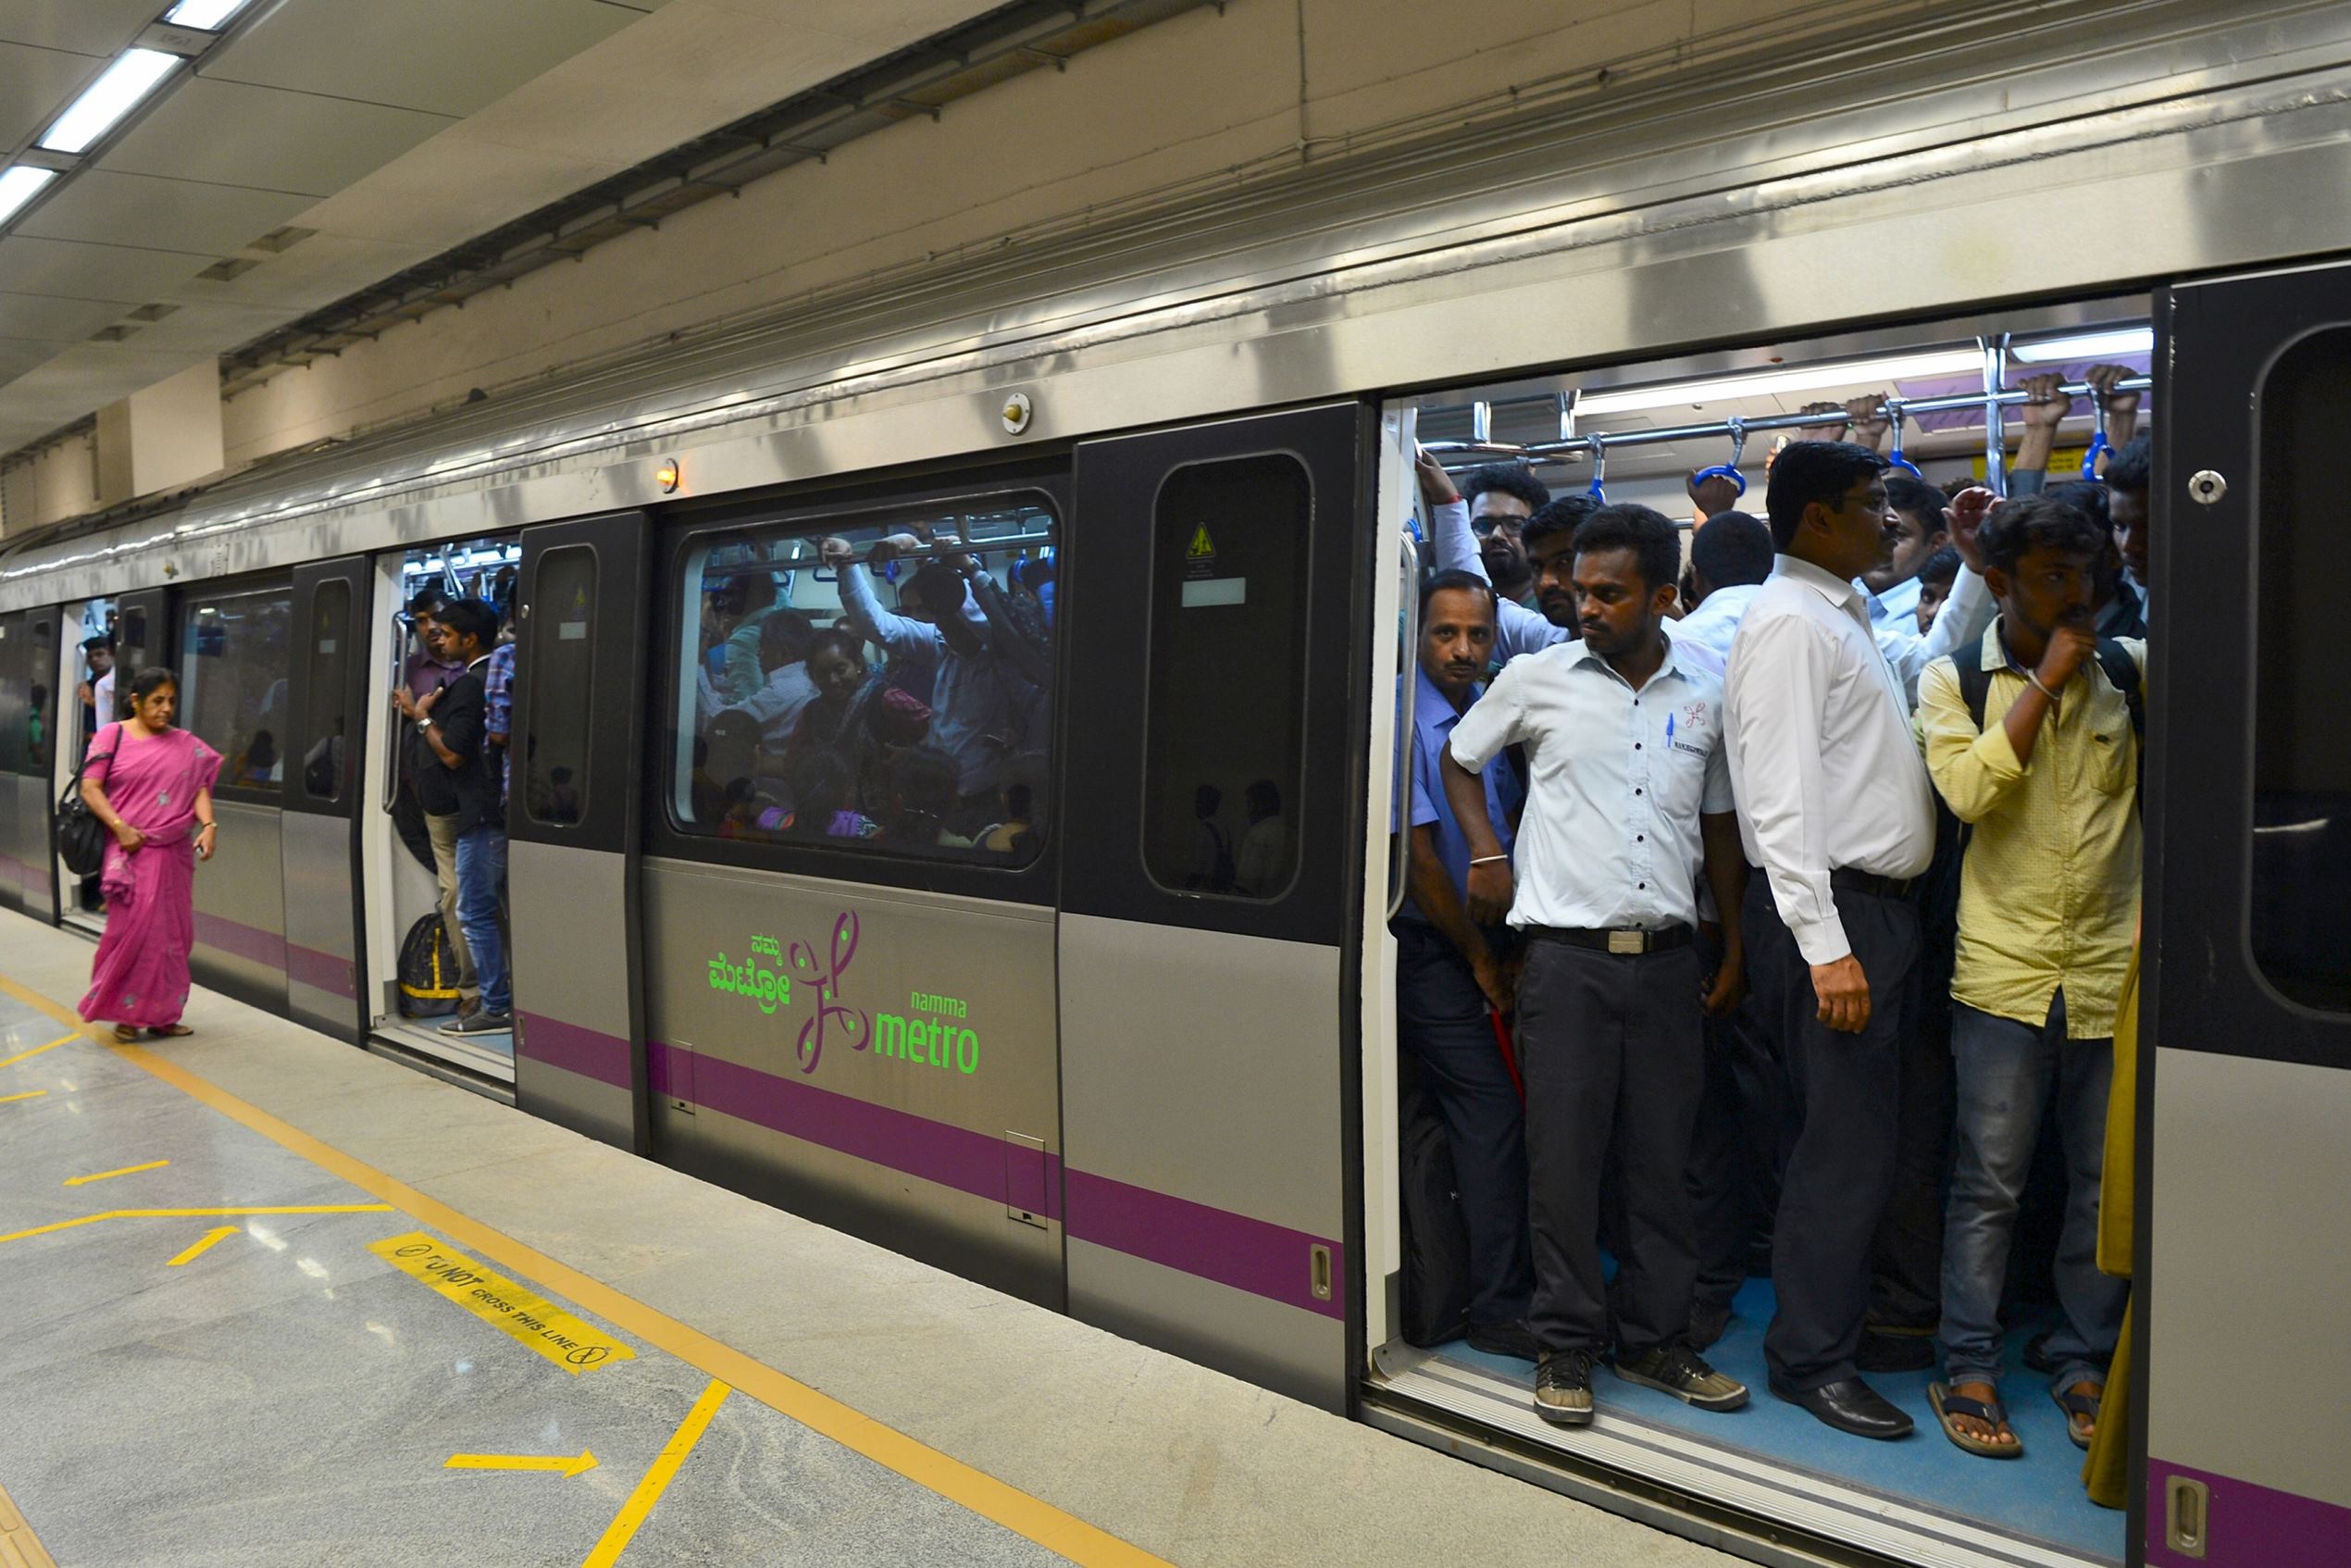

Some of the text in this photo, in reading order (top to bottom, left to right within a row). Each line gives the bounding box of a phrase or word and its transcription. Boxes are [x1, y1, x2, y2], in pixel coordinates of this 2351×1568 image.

[751, 934, 784, 967] ನಮ್ಮ
[709, 952, 790, 1014] ಮೆಟ್ರೋ
[911, 990, 967, 1019] namma
[875, 1013, 979, 1074] metro
[437, 1266, 484, 1287] NOT
[471, 1288, 516, 1313] CROSS
[511, 1311, 546, 1331] THIS
[541, 1329, 578, 1350] LINE
